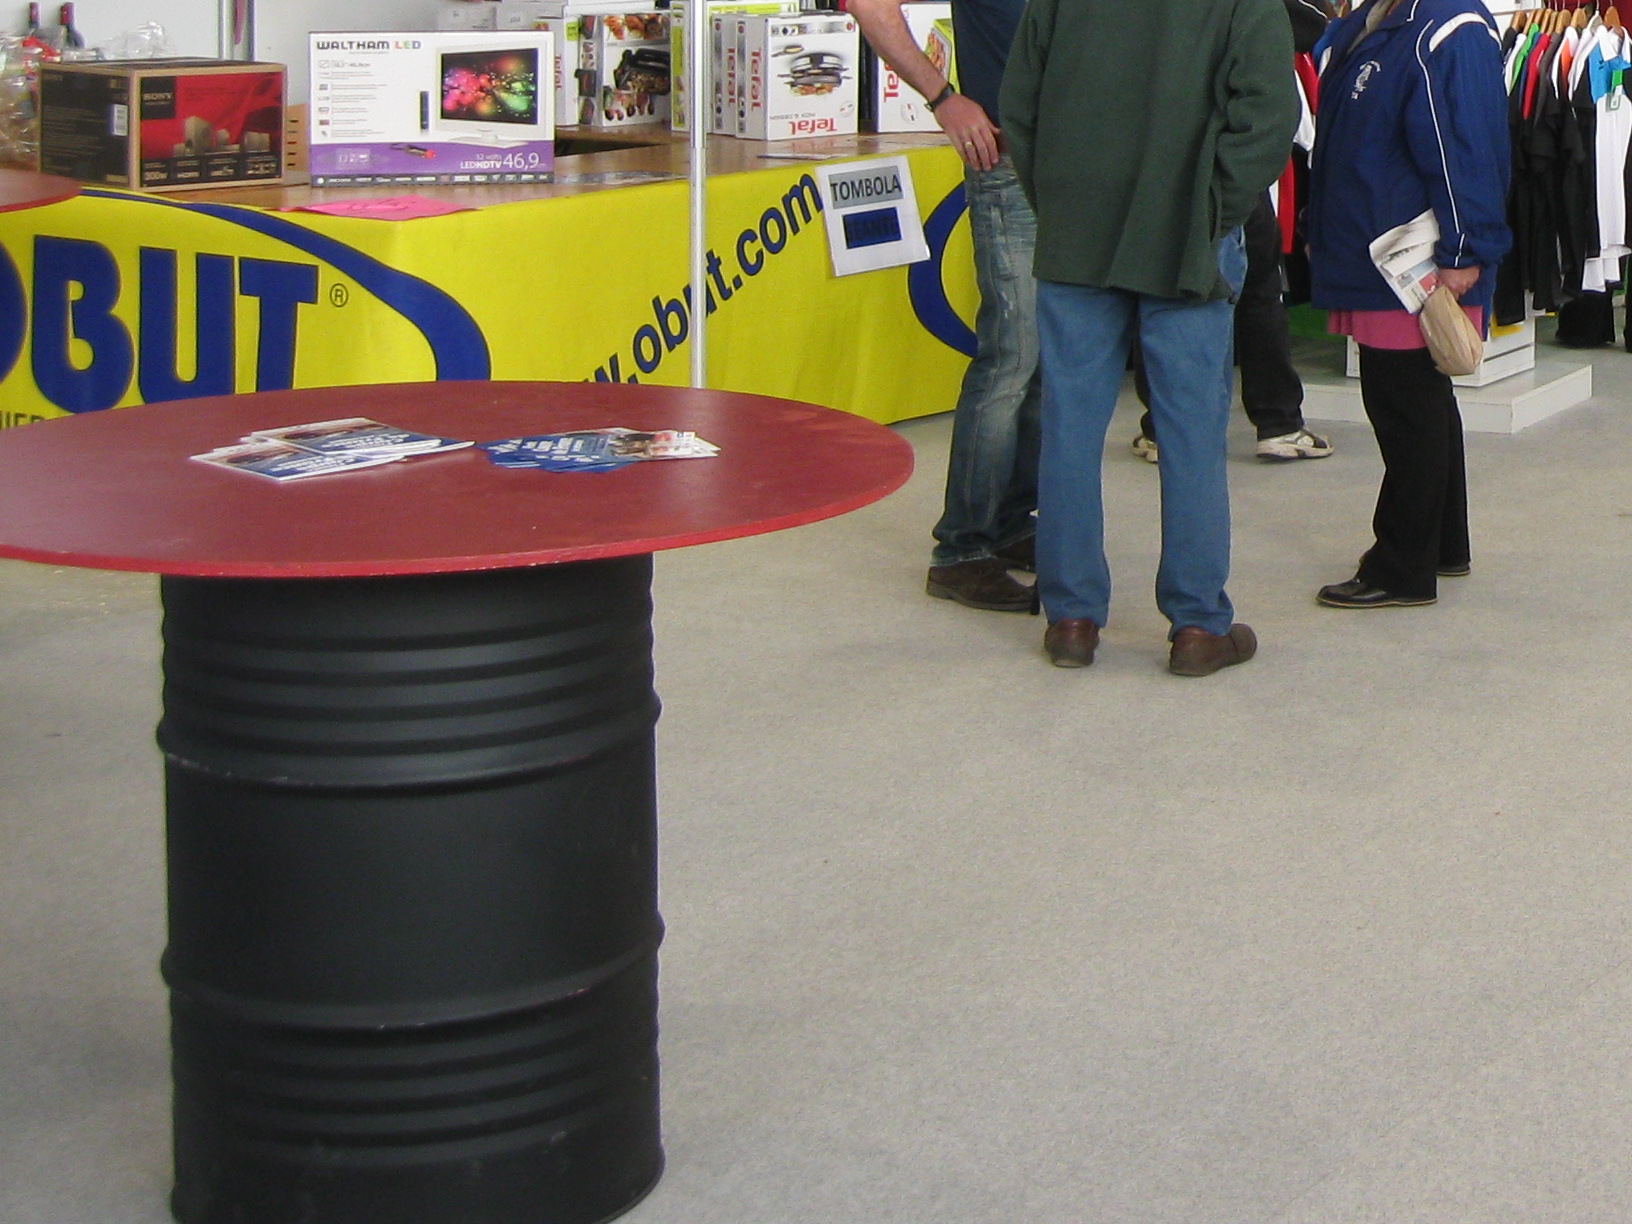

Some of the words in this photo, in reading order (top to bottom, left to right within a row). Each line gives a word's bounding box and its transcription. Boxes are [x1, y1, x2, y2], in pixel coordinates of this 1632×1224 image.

[316, 41, 390, 50] WALTHAM
[395, 41, 422, 50] LED
[750, 47, 762, 110] Tefal
[789, 118, 838, 135] Tefal
[503, 153, 539, 170] 46,9
[831, 174, 902, 202] TOMBOLA
[0, 235, 319, 414] BUT
